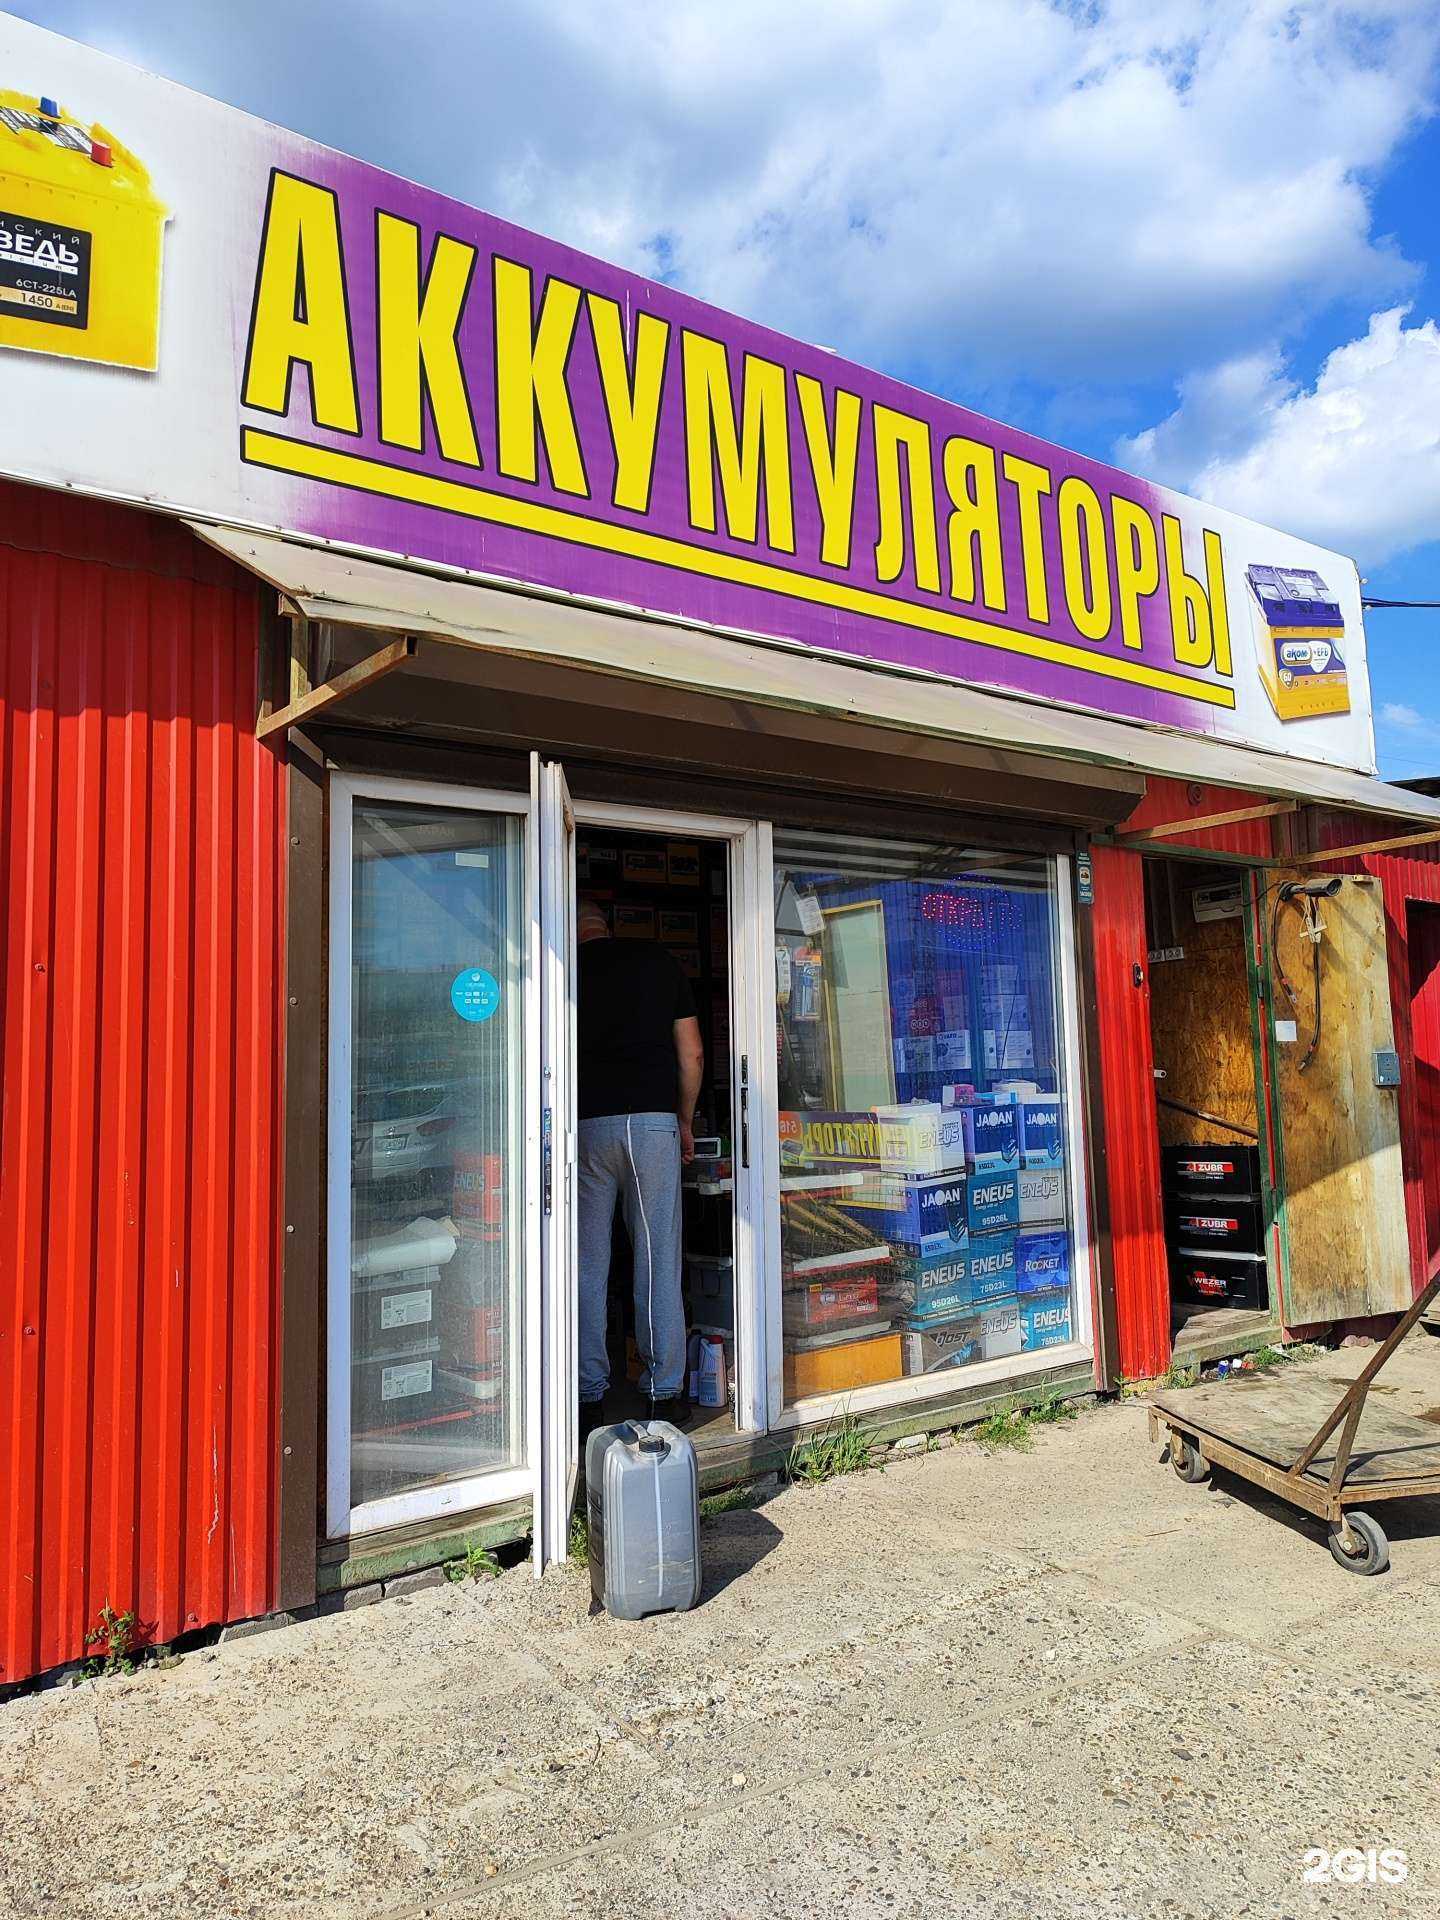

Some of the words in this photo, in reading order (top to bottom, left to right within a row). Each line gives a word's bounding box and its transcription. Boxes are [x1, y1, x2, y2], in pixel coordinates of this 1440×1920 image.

[21, 292, 53, 308] 1450
[241, 168, 1234, 678] АККУМУЛЯТОРЫ
[976, 1111, 1013, 1128] JAAN
[1026, 1112, 1057, 1125] JAAN
[1198, 1163, 1224, 1172] ZUBR
[921, 1188, 961, 1208] JAAN
[973, 1184, 1014, 1206] ENEUS
[1020, 1179, 1058, 1199] ENEUS
[982, 1214, 1009, 1226] 95D26L
[1201, 1220, 1228, 1229] ZUBR
[971, 1252, 1014, 1276] ENEUS
[921, 1262, 965, 1288] ENEUS
[1194, 1277, 1227, 1288] WEZER
[980, 1315, 1017, 1336] ENEUS
